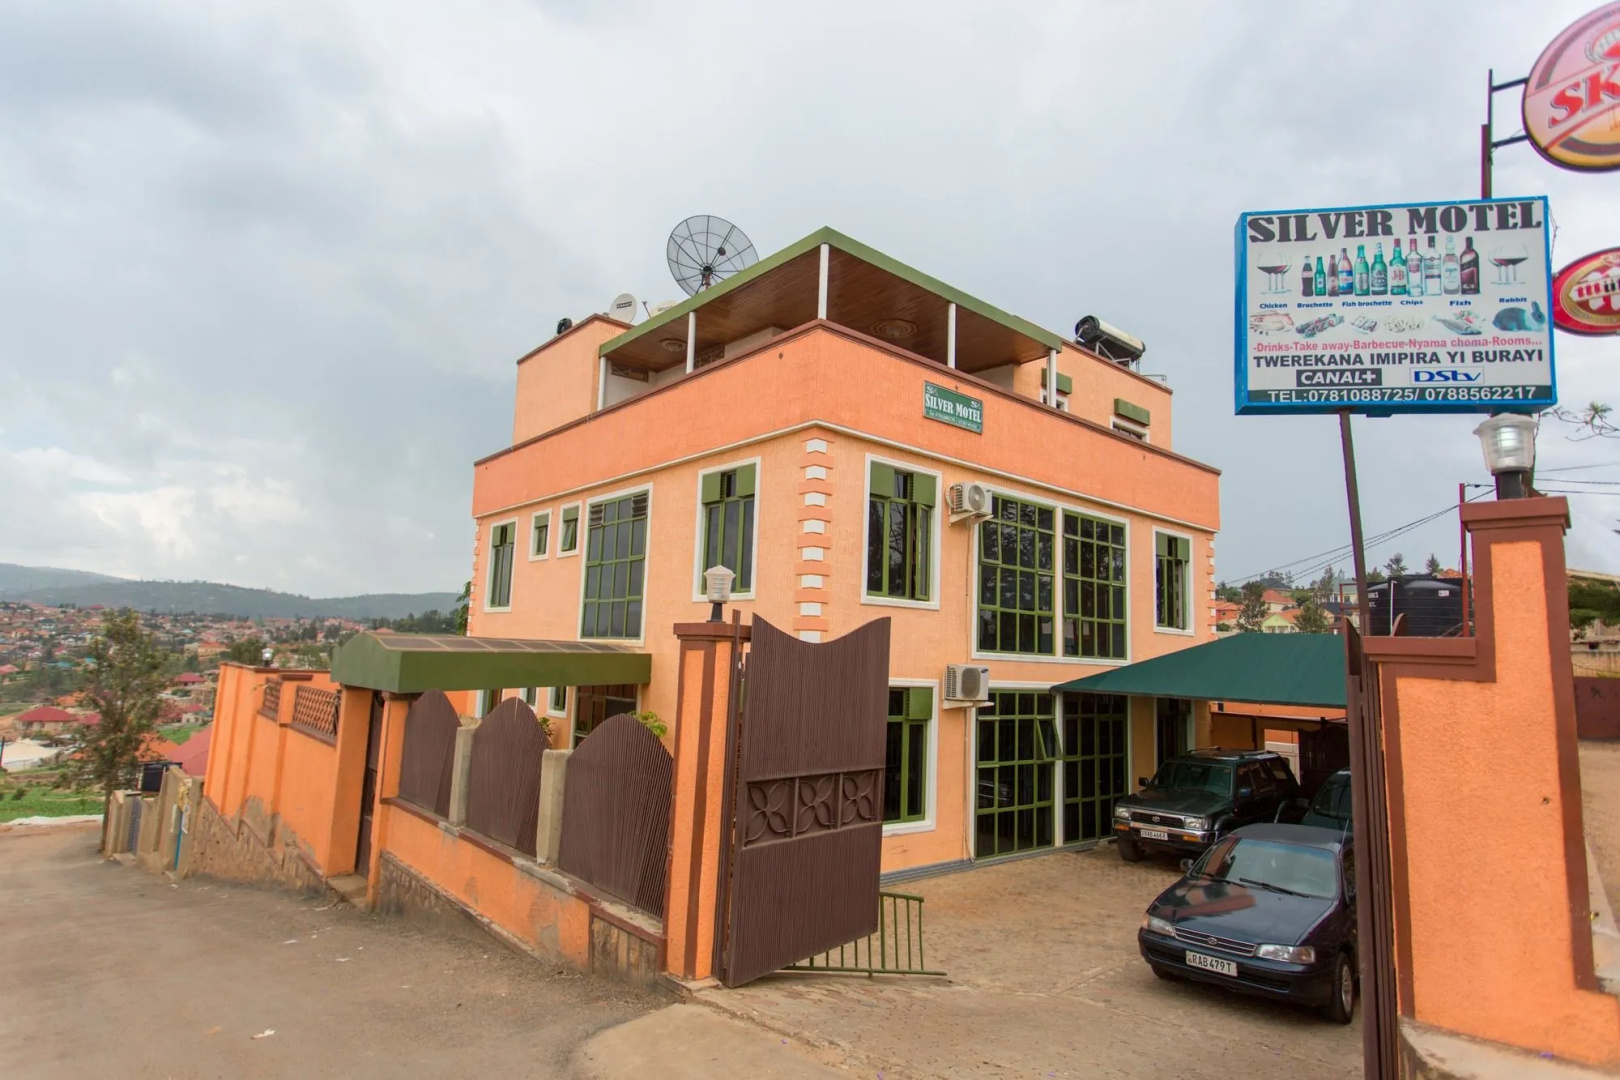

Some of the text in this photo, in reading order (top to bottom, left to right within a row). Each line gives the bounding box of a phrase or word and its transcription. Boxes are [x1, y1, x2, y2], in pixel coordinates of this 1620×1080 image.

[1248, 202, 1542, 243] SILVER MOTEL
[1253, 349, 1542, 367] TWEREKANA IMIPIRA YI BURAYI
[1301, 370, 1376, 384] CANAL+
[1414, 370, 1481, 382] DStv
[1425, 387, 1536, 401] 0788562217
[925, 394, 953, 414] SILVER
[956, 403, 981, 423] MOTEL
